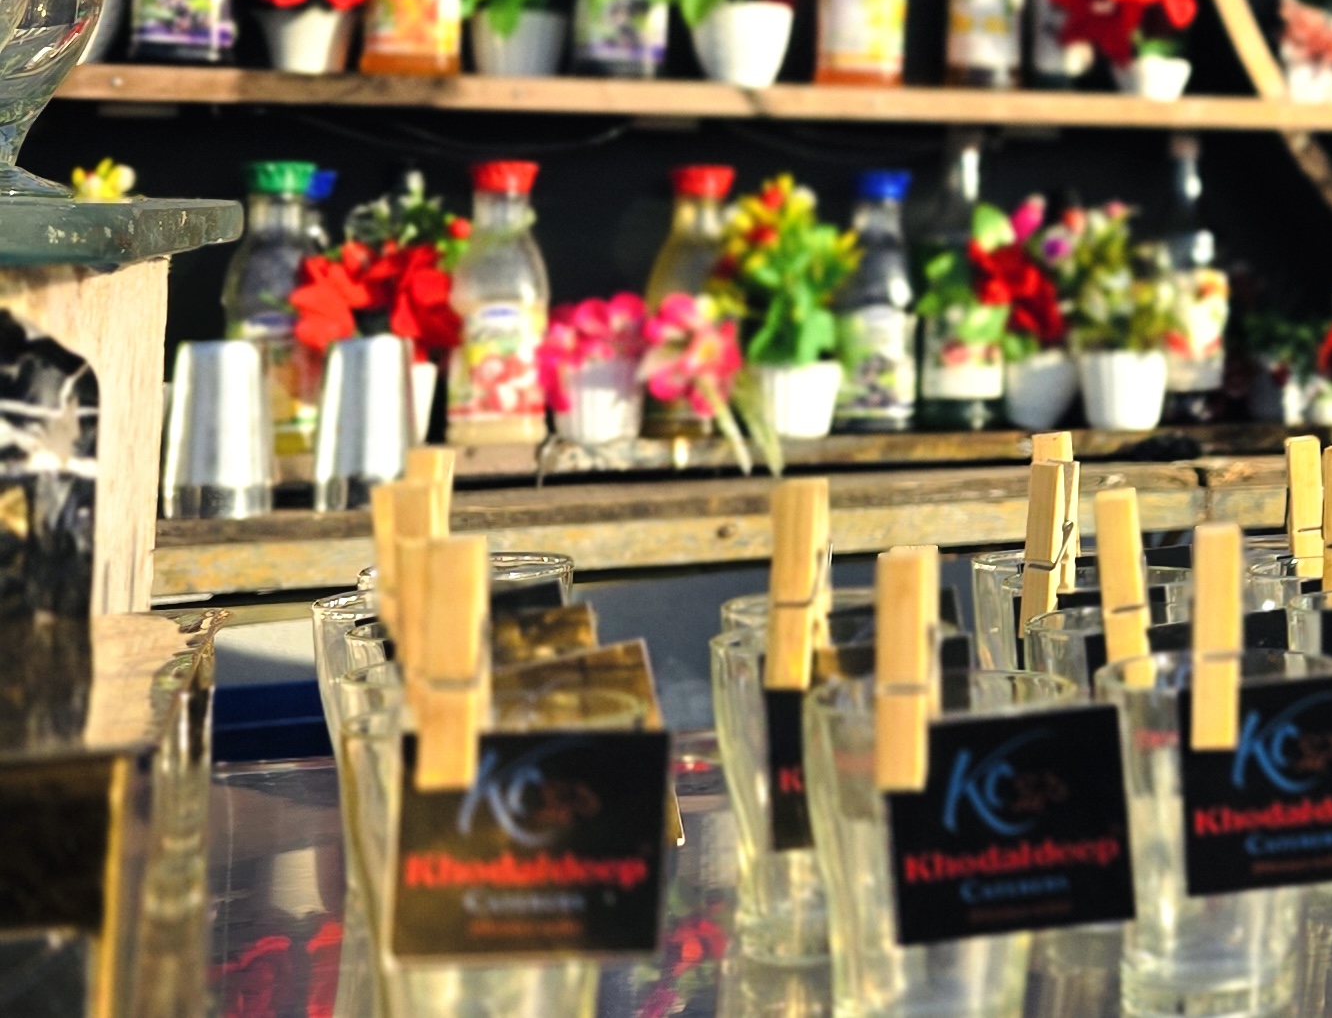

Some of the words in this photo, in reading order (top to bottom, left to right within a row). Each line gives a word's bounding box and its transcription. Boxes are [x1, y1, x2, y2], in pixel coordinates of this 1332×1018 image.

[943, 729, 1042, 836] KC
[1233, 693, 1325, 792] KC
[904, 835, 1120, 884] Khodaldeep
